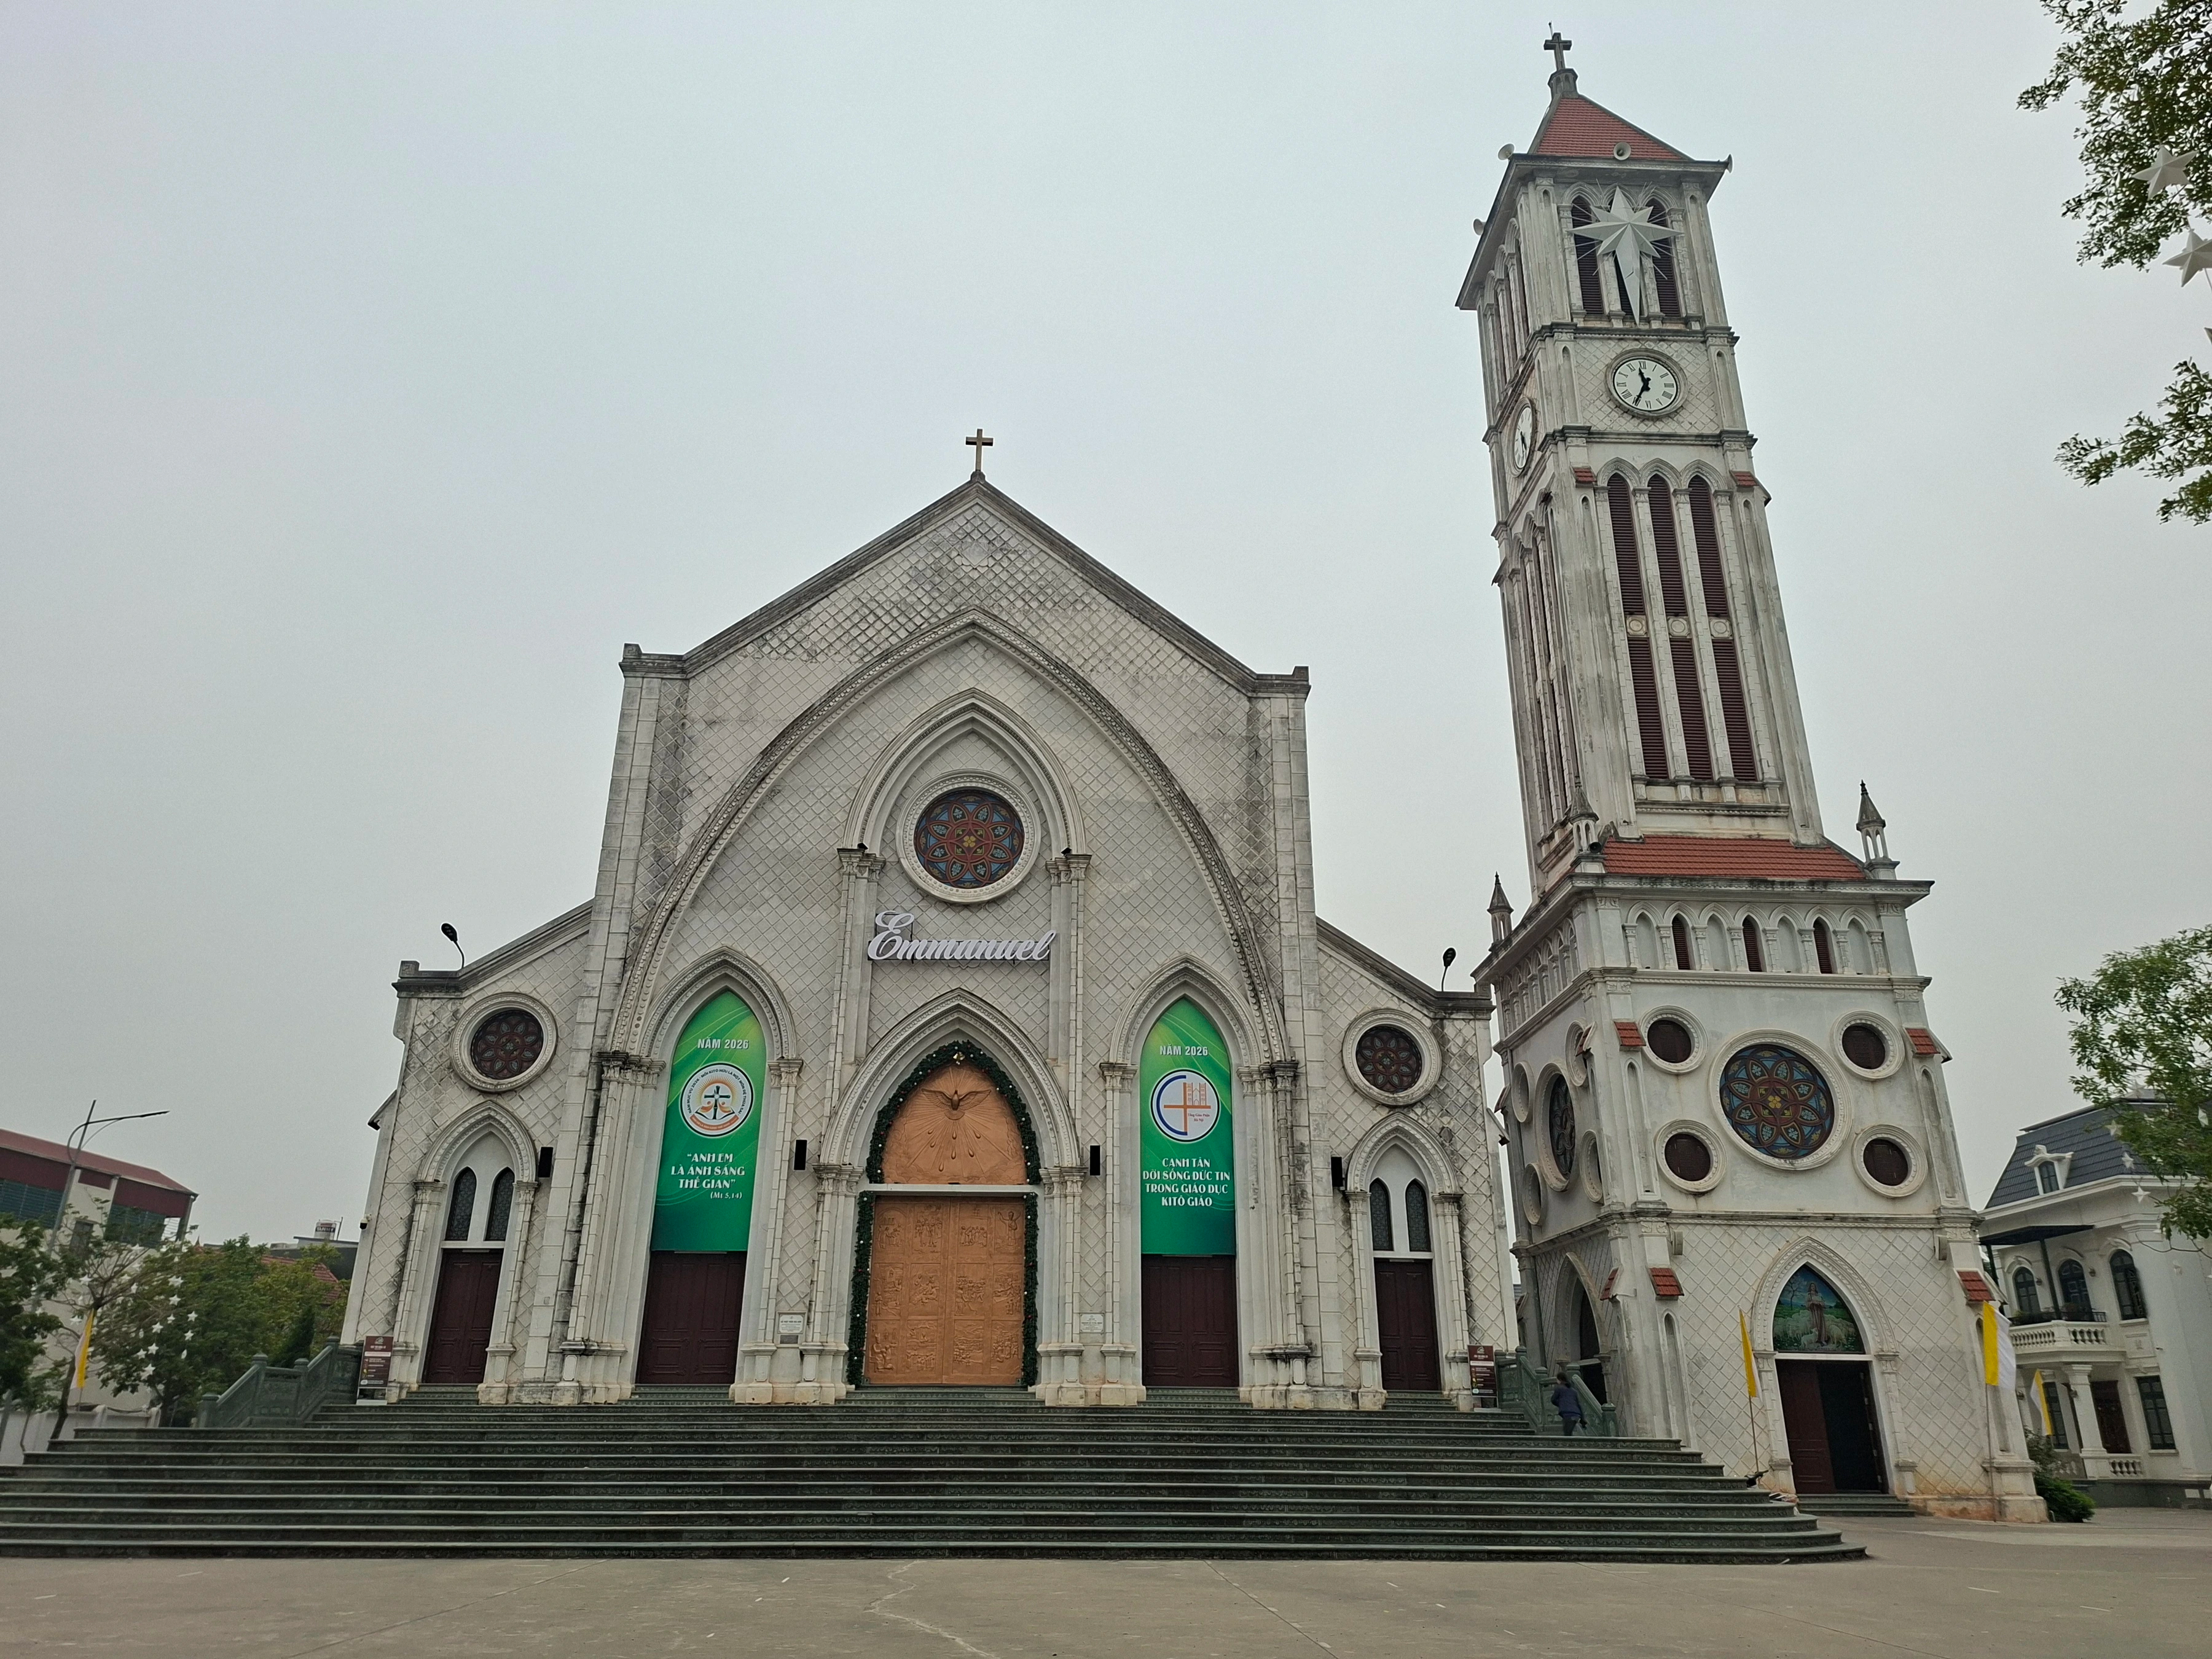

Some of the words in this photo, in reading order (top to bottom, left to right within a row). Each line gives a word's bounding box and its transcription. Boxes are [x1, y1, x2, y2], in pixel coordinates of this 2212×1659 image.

[867, 910, 1057, 960] Emmanuel
[697, 1037, 721, 1049] NĂM
[724, 1039, 750, 1049] 2026
[1159, 1043, 1182, 1056] NĂM
[1185, 1046, 1209, 1056] 2026
[718, 1153, 734, 1163] EM
[1162, 1158, 1190, 1167] CANH
[1191, 1156, 1210, 1167] TÂN
[671, 1164, 684, 1175] LÀ
[687, 1164, 712, 1175] ÁNH
[714, 1164, 745, 1175] SÁNG
[1163, 1167, 1191, 1180] SỐNG
[1215, 1171, 1230, 1181] TIN
[679, 1176, 700, 1189] THẾ
[1145, 1183, 1179, 1193] TRONG
[1181, 1182, 1206, 1193] GIÁO
[1208, 1184, 1228, 1195] DỤC
[1161, 1195, 1185, 1206] KITÔ
[1187, 1195, 1212, 1206] GIÁO
